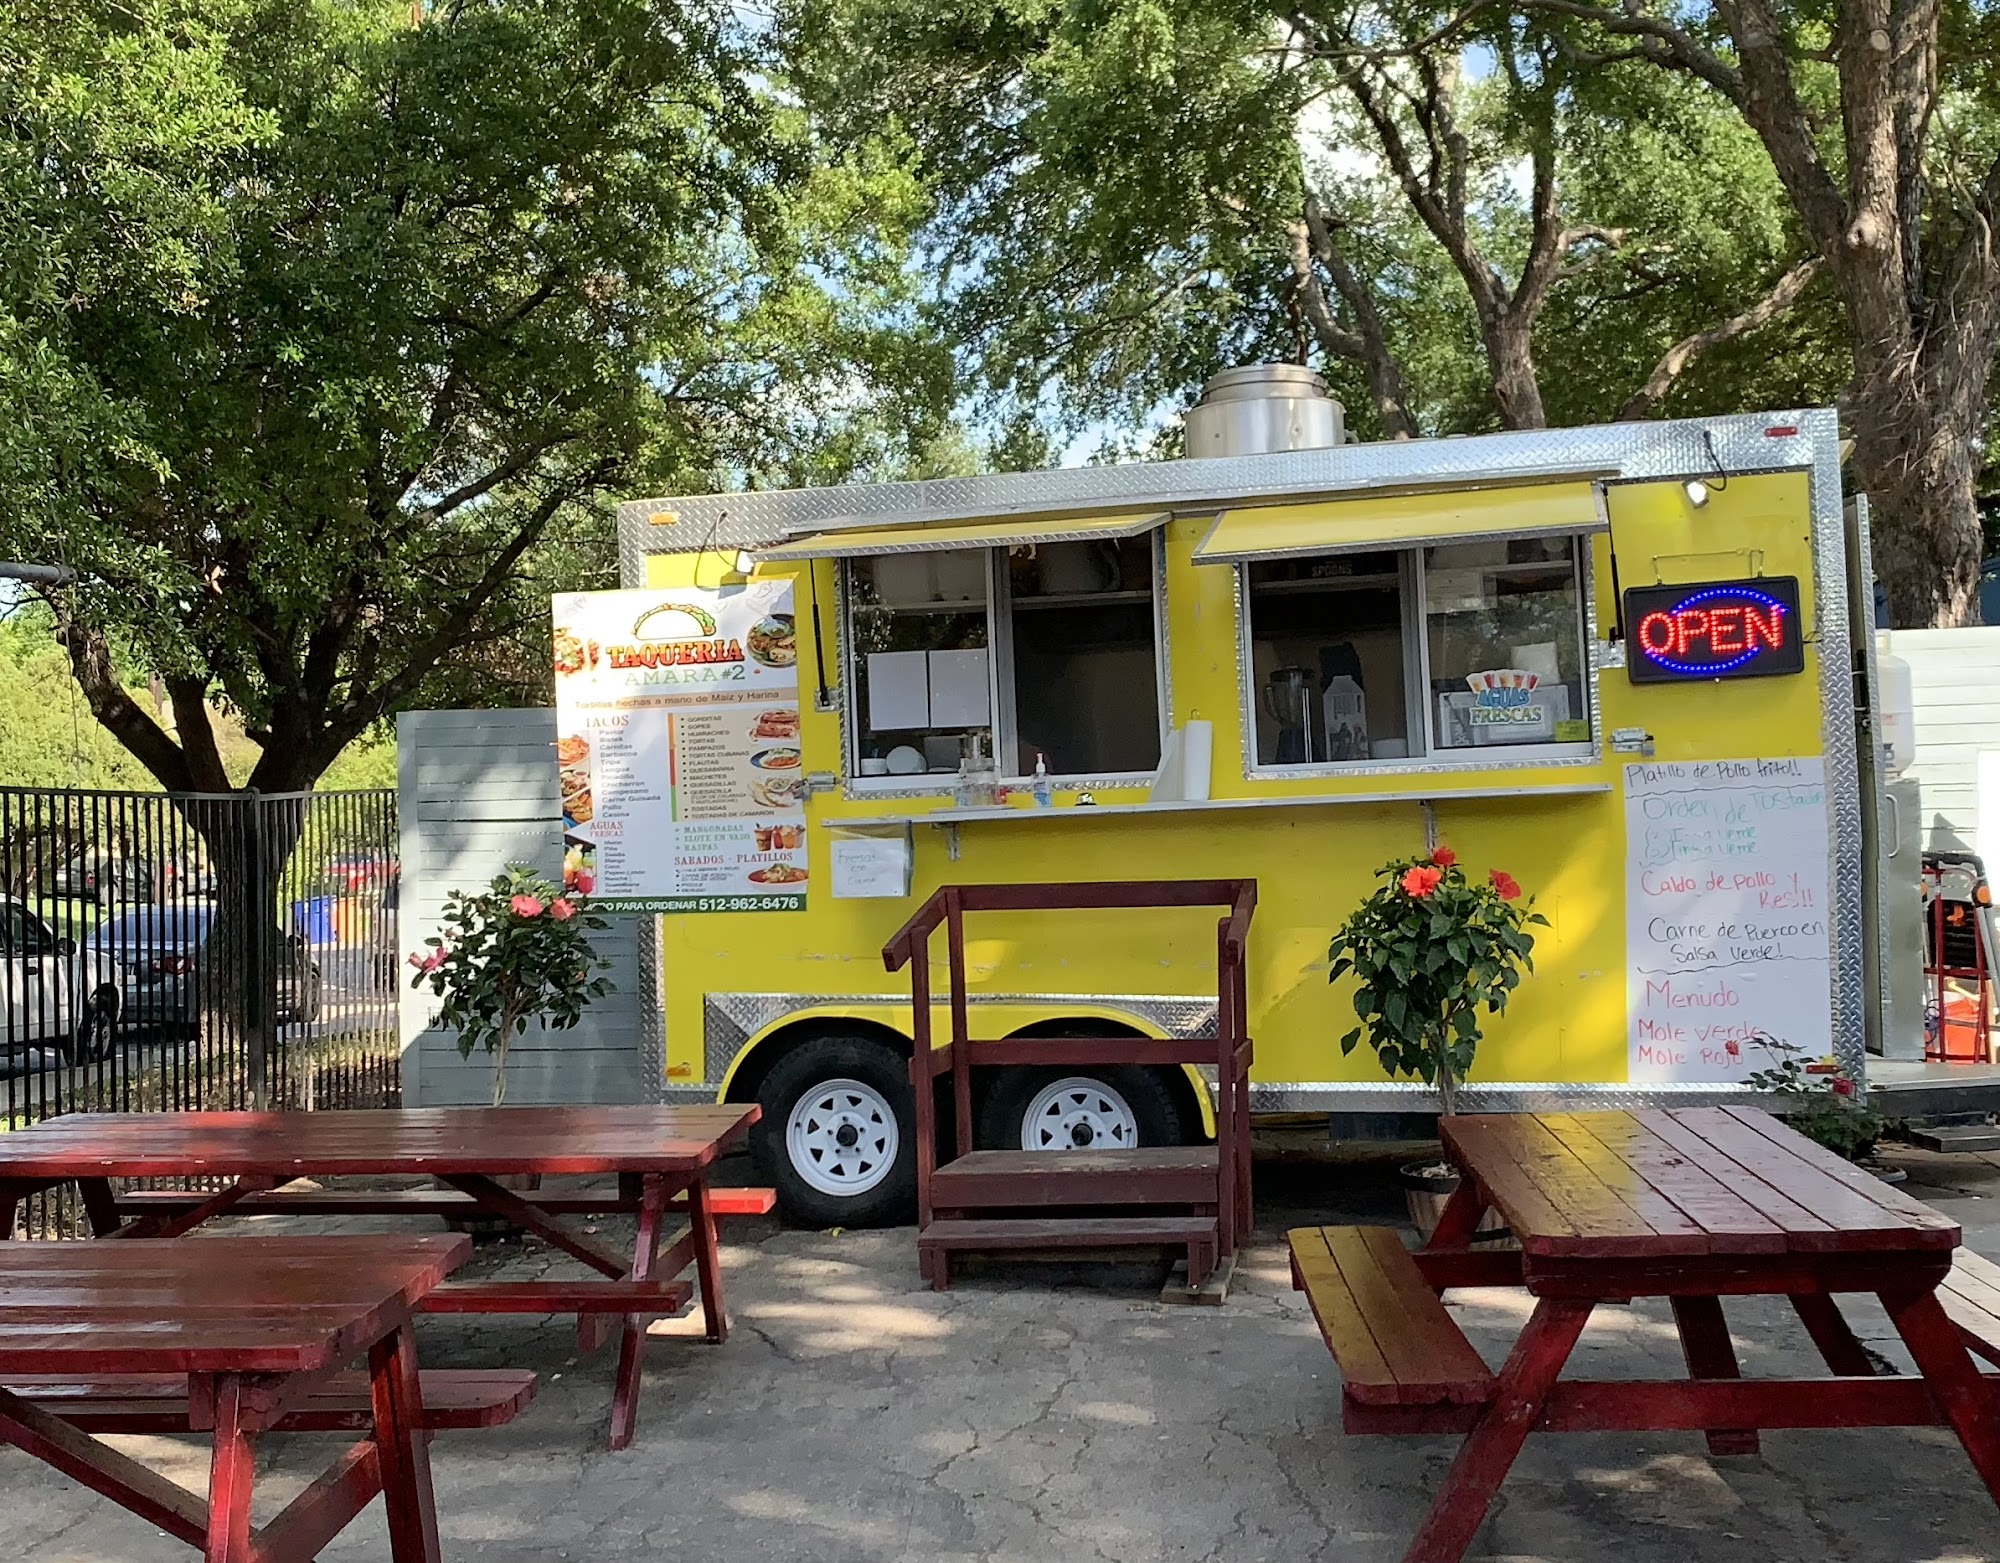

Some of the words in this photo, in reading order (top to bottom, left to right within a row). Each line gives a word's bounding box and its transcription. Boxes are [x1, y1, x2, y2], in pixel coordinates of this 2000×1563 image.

[1639, 604, 1783, 656] OPEN
[606, 638, 745, 669] TAQUERIA
[624, 667, 719, 687] AMARA
[721, 664, 745, 681] #2
[616, 697, 651, 708] hechas
[664, 695, 691, 705] mano
[696, 694, 708, 703] de
[738, 694, 744, 704] y
[747, 690, 779, 700] Harina
[1477, 687, 1531, 708] AGUAS
[586, 714, 630, 728] TACOS
[1471, 707, 1542, 724] FRESCAS
[689, 759, 719, 767] FLAUTAS
[1626, 763, 1686, 788] Platillo
[1693, 763, 1716, 778] de
[1717, 760, 1751, 779] Pollo
[602, 796, 626, 804] Carne
[628, 794, 661, 802] Guisada
[1725, 799, 1752, 824] de
[590, 820, 624, 830] AGUAS
[684, 824, 744, 834] MANGONADAS
[685, 834, 712, 843] ELOTE
[714, 833, 726, 841] EN
[729, 832, 750, 841] VASO
[685, 843, 718, 852] RASPAS
[674, 854, 724, 866] SABADOS
[737, 852, 793, 863] PLATILLOS
[1641, 870, 1697, 896] Caldo
[1705, 871, 1732, 891] de
[616, 901, 645, 912] PARA
[646, 899, 697, 911] ORDENAR
[699, 896, 799, 911] 512-962-6476
[1648, 917, 1711, 943] Carne
[1717, 922, 1742, 939] de
[1744, 923, 1799, 942] Puerco
[1800, 920, 1825, 936] en
[1669, 943, 1720, 963] Salsa
[1730, 942, 1784, 961] Verde!
[1645, 980, 1740, 1008] Menudo
[1638, 1018, 1688, 1042] Mole
[1637, 1045, 1688, 1066] Mole
